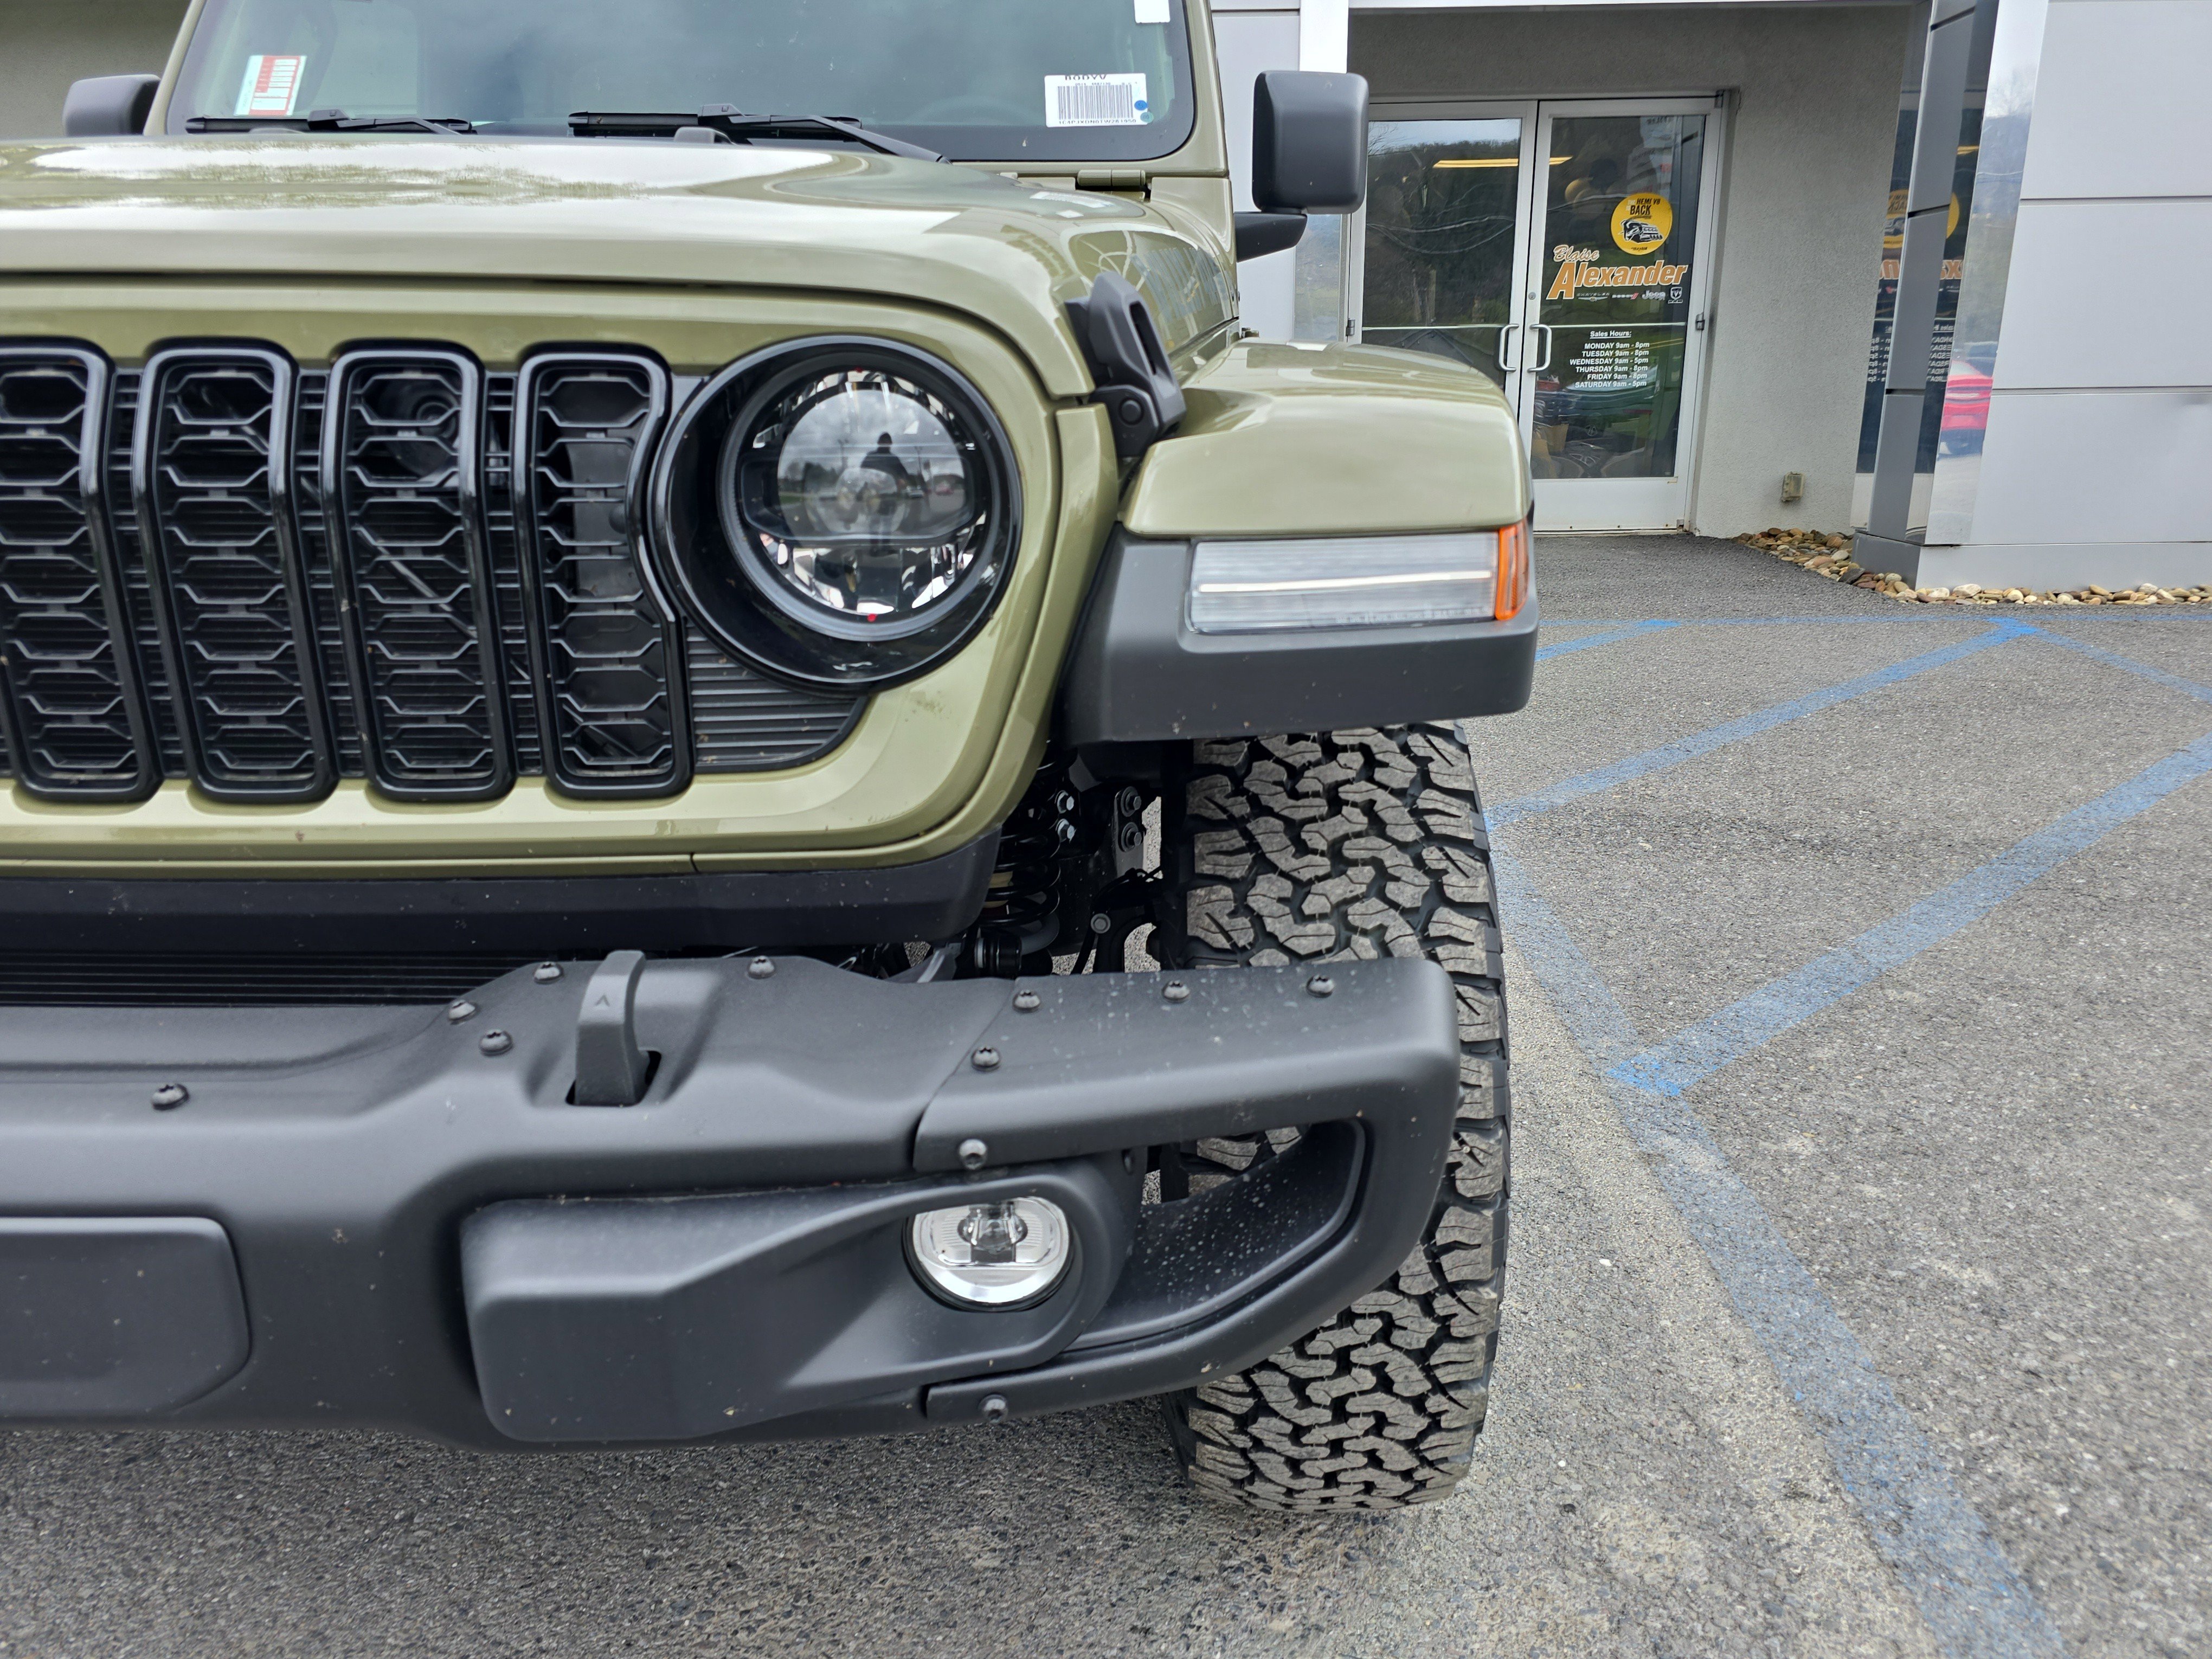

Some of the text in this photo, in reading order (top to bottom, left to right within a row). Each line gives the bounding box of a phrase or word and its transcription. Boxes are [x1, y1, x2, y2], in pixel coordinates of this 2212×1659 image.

[1630, 205, 1651, 215] BACK
[1553, 245, 1599, 262] Blaise
[1546, 260, 1689, 300] Alexander
[1642, 290, 1666, 300] Jeep
